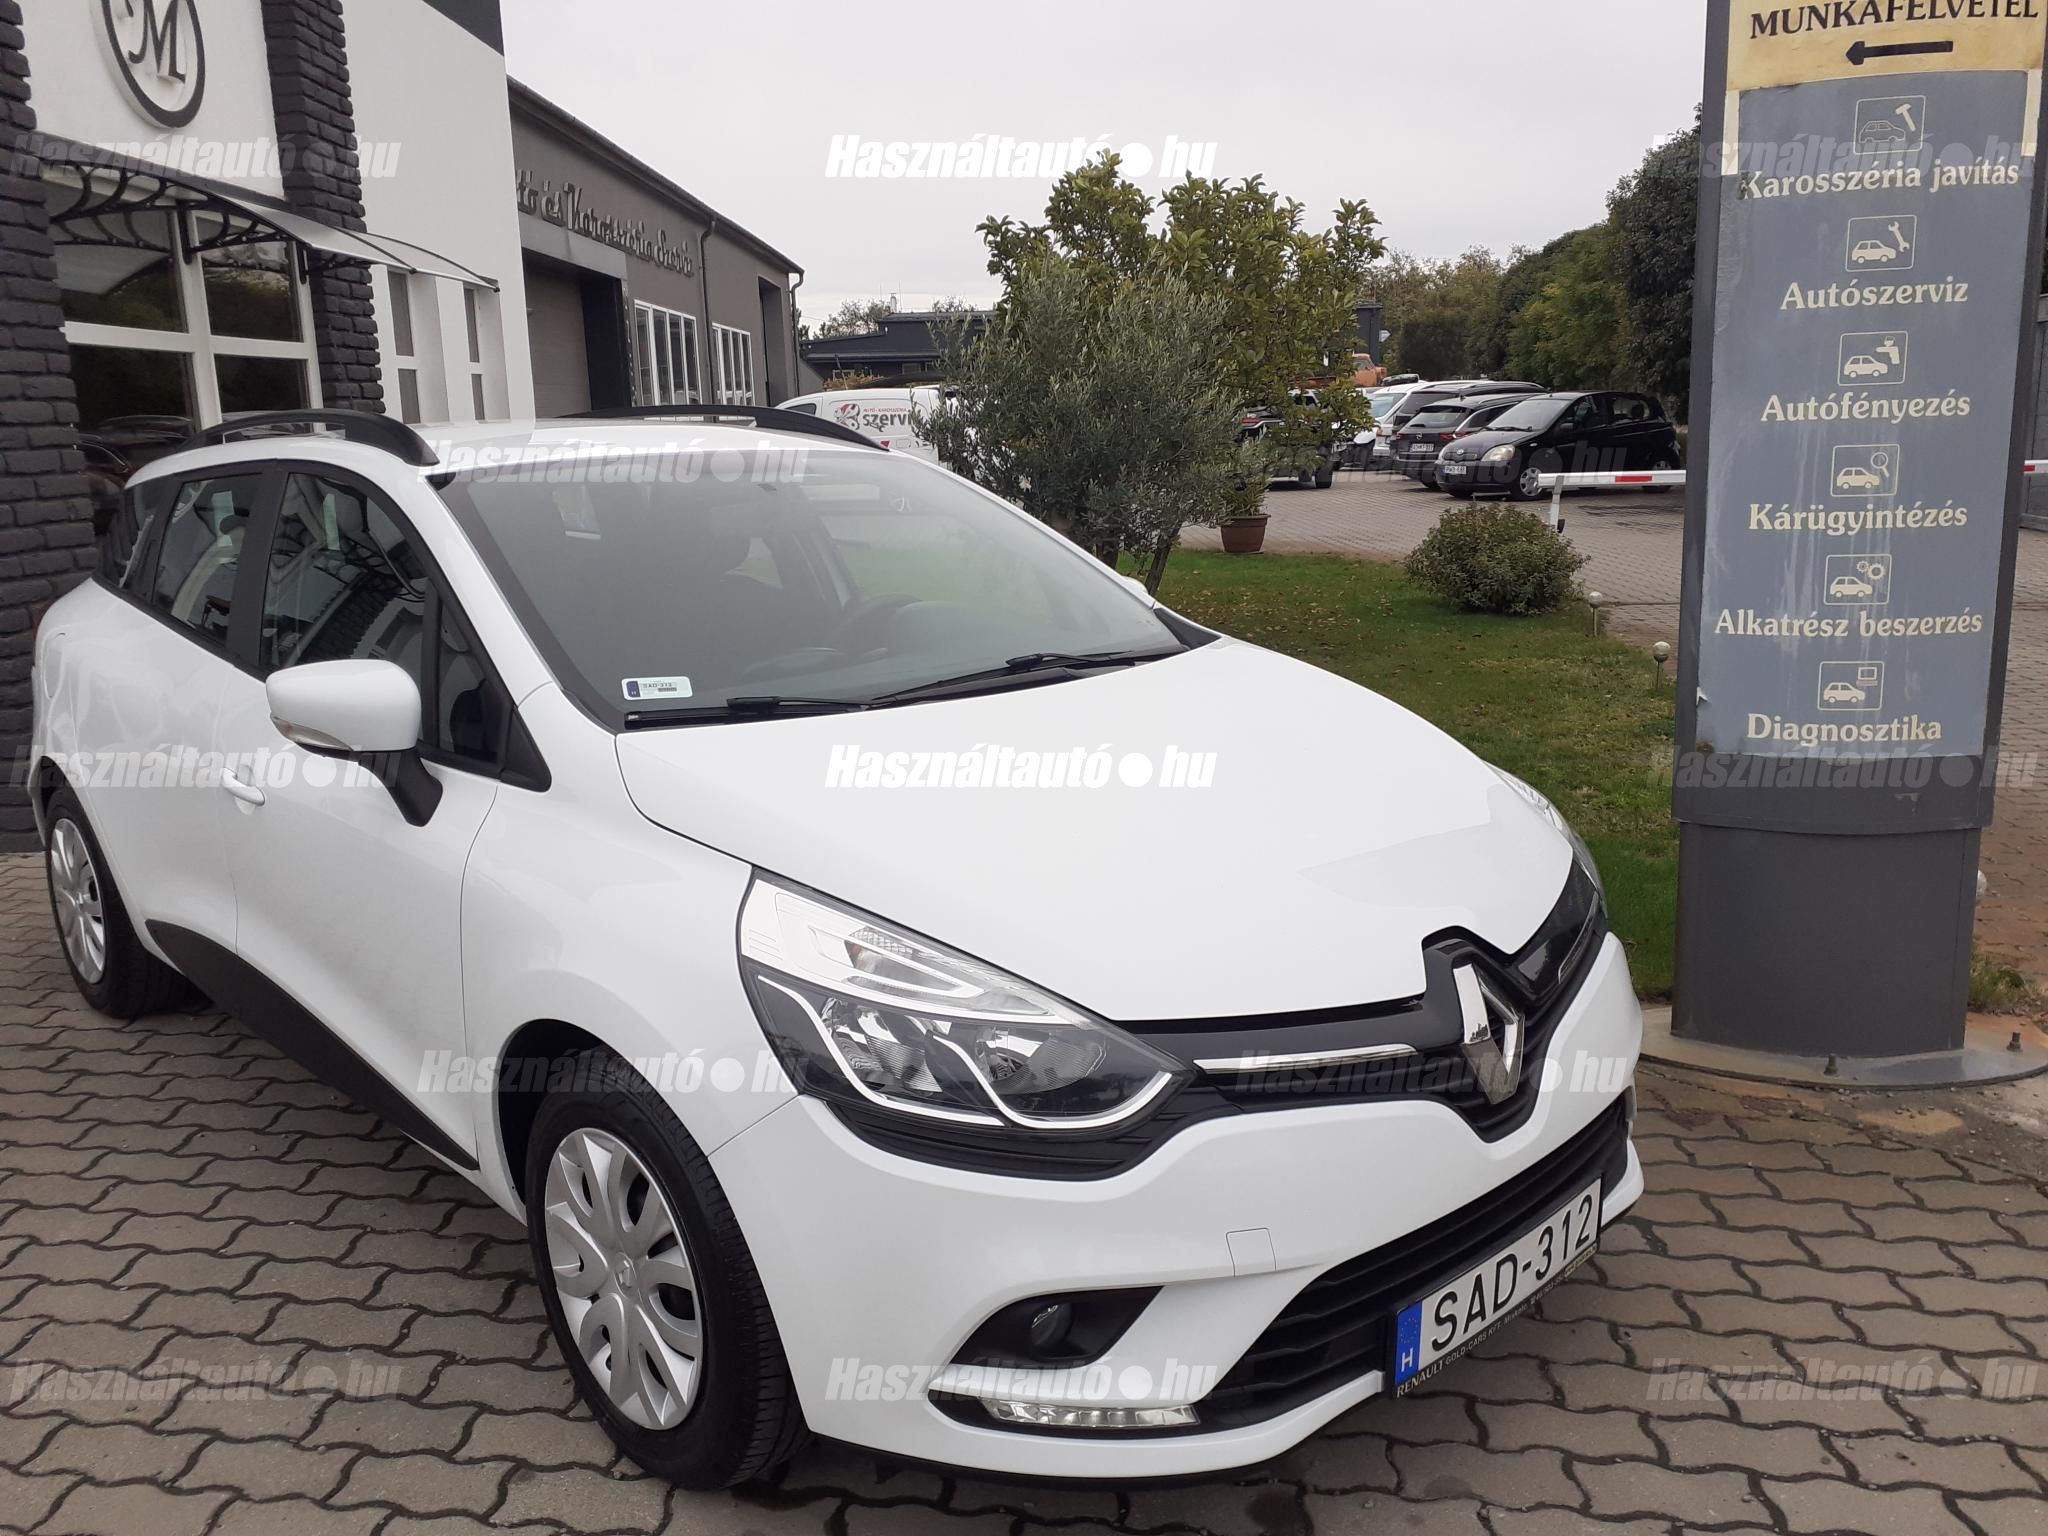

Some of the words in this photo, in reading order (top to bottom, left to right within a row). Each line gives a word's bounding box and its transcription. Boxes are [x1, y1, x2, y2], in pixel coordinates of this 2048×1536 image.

[1742, 160, 1921, 200] Karosszéria
[1929, 156, 2019, 193] javítás
[1780, 276, 1969, 311] Autószerviz
[862, 409, 912, 427] szervi
[1760, 389, 1971, 424] Autófényezés
[1748, 500, 1968, 536] Kárügyintézés
[1714, 609, 1849, 638] Alkatrész
[1859, 608, 1983, 638] beszerzés
[1747, 713, 1942, 748] Diagnosztika
[1431, 1194, 1593, 1352] SAD-312
[1401, 1347, 1414, 1372] H
[1396, 1359, 1444, 1398] RENAULT
